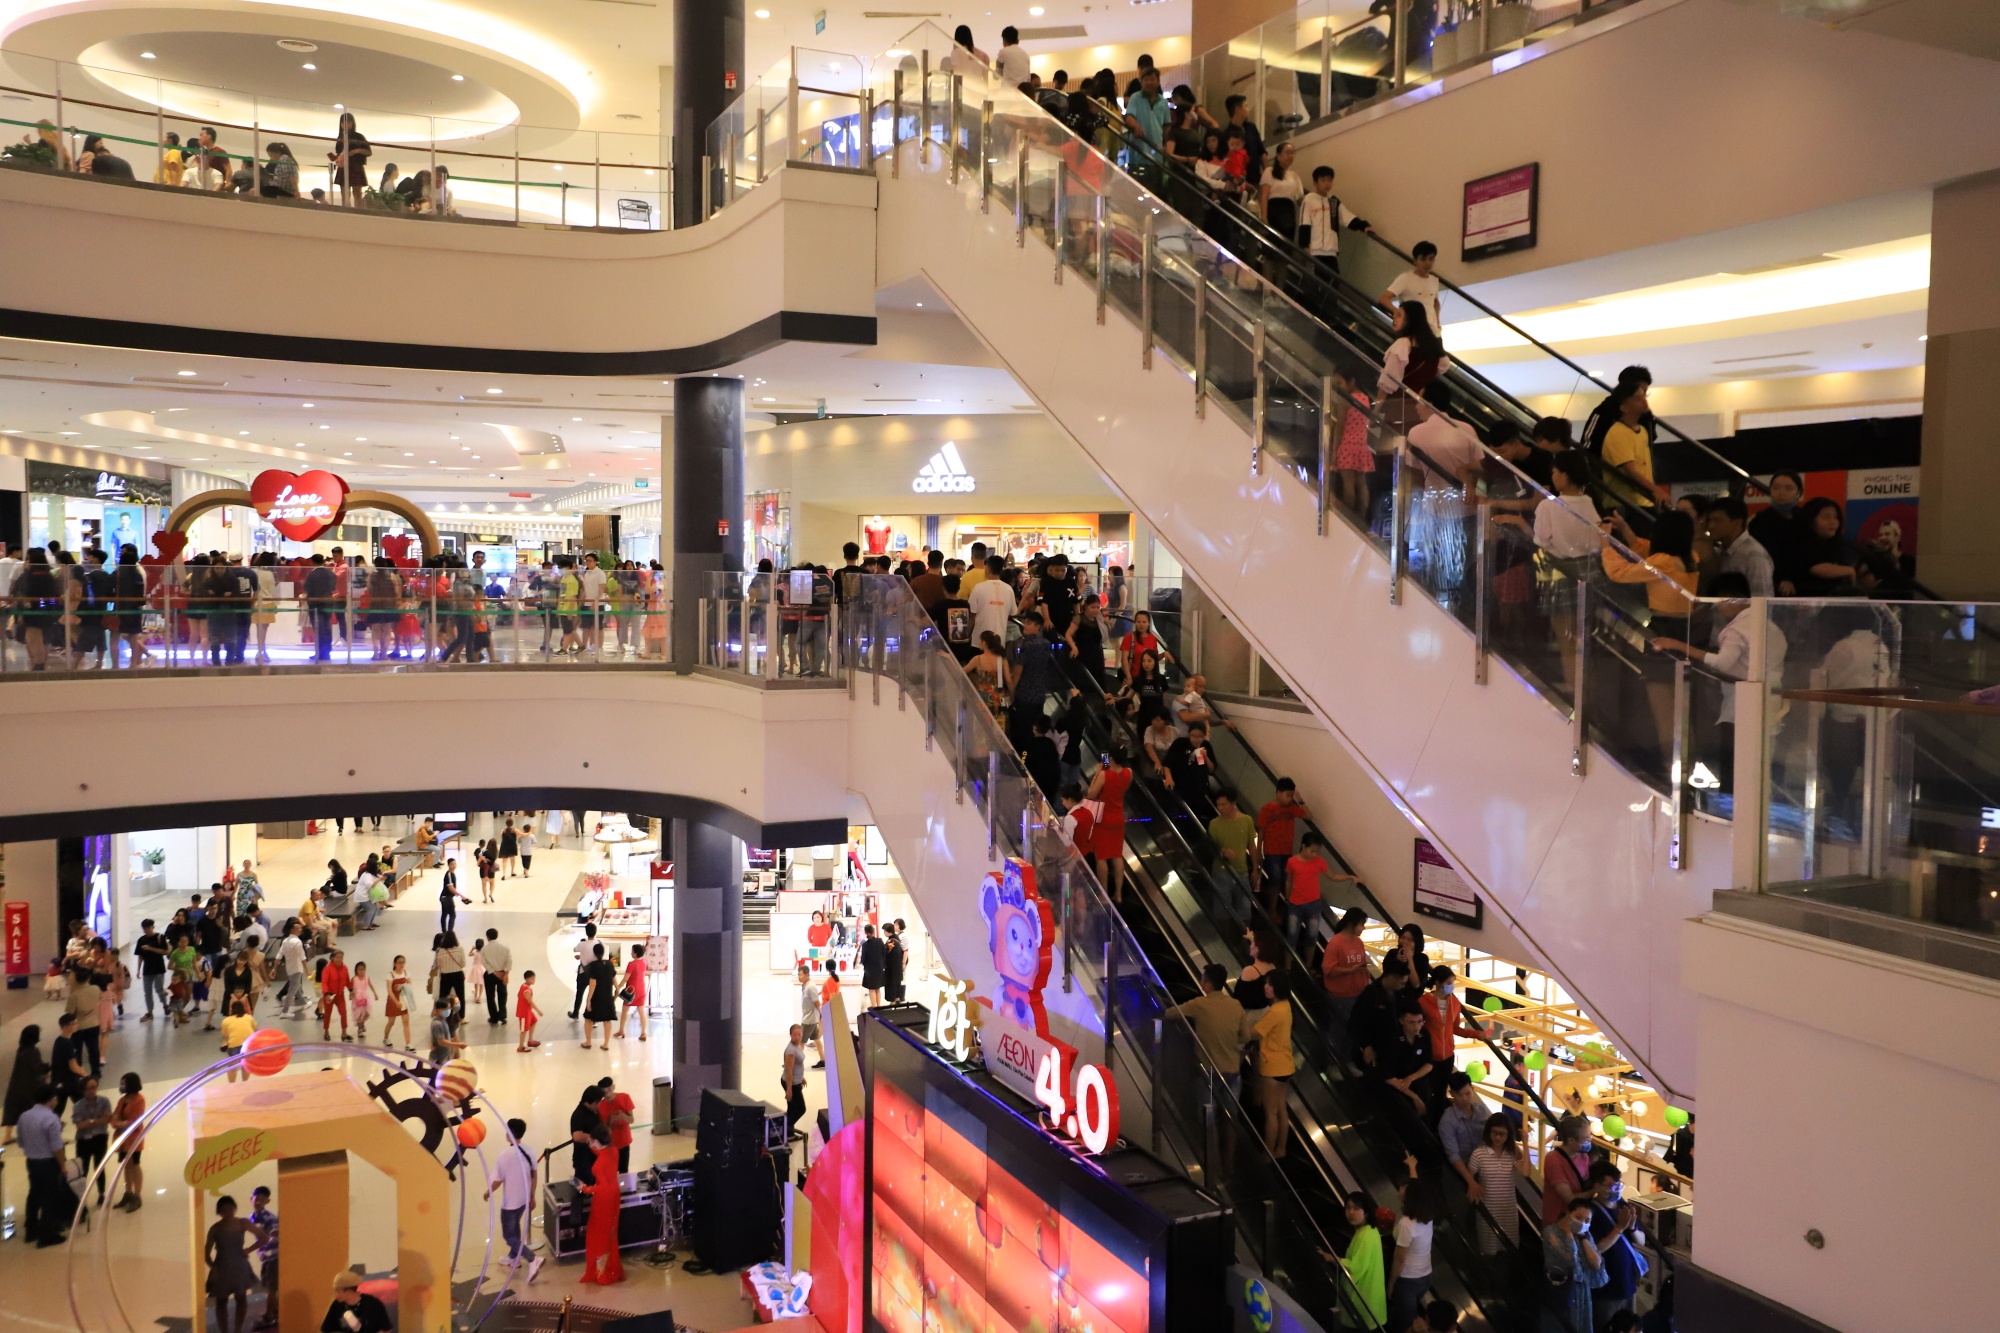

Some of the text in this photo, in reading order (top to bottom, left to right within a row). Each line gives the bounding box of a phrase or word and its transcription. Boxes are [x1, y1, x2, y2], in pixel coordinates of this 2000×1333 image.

[275, 485, 322, 505] Love
[912, 473, 976, 493] adidas
[1864, 482, 1911, 495] ONLINE
[12, 913, 22, 964] SALE
[928, 974, 971, 1062] Tết
[1035, 1046, 1110, 1154] 4.0
[191, 1131, 265, 1185] CHEESE
